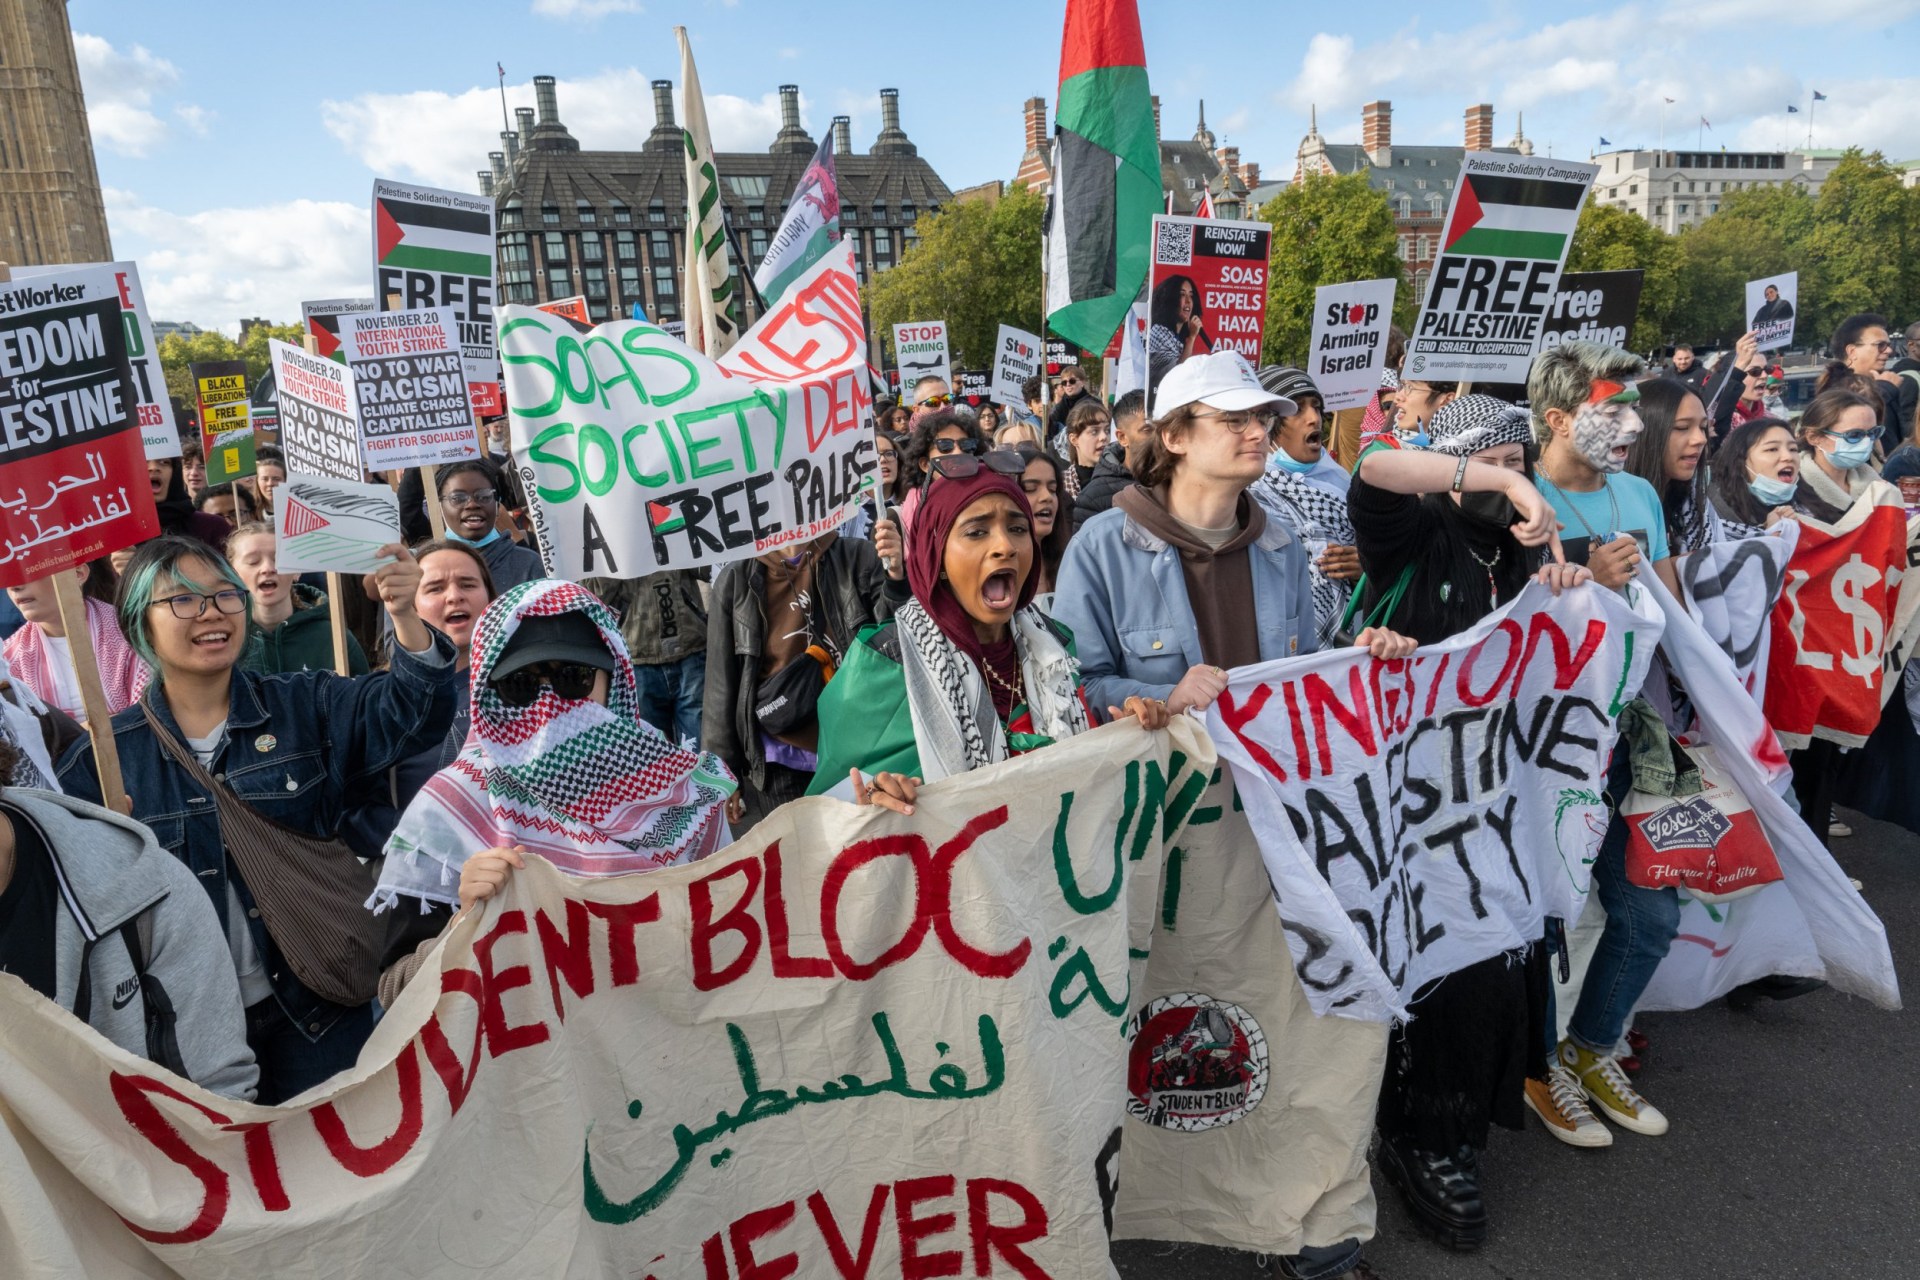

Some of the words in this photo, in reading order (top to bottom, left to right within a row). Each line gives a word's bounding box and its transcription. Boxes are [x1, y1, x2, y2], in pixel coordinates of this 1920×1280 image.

[1467, 159, 1505, 172] Palestine
[1507, 162, 1546, 177] Solidarity
[1547, 166, 1591, 182] Campaign
[377, 185, 411, 199] Palestine
[413, 191, 452, 206] Solidarity
[453, 198, 490, 212] Campaign
[1204, 227, 1257, 242] REINSTATE
[1215, 242, 1246, 256] NOW!
[1220, 266, 1263, 285] SOAS
[1427, 256, 1558, 314] FREE
[13, 283, 86, 311] Worker
[378, 267, 492, 323] FREE
[1205, 292, 1262, 311] EXPELS
[1551, 289, 1604, 319] ree
[307, 305, 343, 314] Palestine
[355, 314, 422, 330] NOVEMBER
[423, 312, 439, 324] 20
[1218, 315, 1260, 333] HAYA
[1419, 312, 1540, 339] PALESTINE
[355, 325, 446, 343] INTERNATIONAL
[899, 326, 942, 342] STOP
[1319, 329, 1379, 351] Arming
[357, 341, 400, 357] YOUTH
[403, 337, 448, 353] STRIKE
[462, 348, 491, 358] PATION
[901, 342, 944, 354] ARMING
[1042, 342, 1065, 352] ree
[1211, 338, 1257, 355] ADAM
[1416, 341, 1436, 352] END
[1438, 341, 1474, 353] ISRAELI
[1475, 342, 1531, 355] OCCUPATION
[282, 348, 328, 378] NOVEMBER
[329, 366, 342, 382] 20
[352, 362, 382, 381] NO
[384, 359, 411, 378] TO
[413, 355, 461, 374] WAR
[500, 317, 700, 418] SOAS
[1000, 354, 1034, 375] Arming
[1045, 353, 1078, 365] estine
[1320, 350, 1373, 375] Israel
[11, 378, 41, 400] for
[207, 377, 238, 390] BLACK
[281, 362, 347, 398] INTERNATIONAL
[357, 373, 464, 405] RACISM
[283, 376, 311, 400] YOUTH
[311, 389, 348, 413] STRIKE
[0, 379, 126, 453] ESTINE
[215, 406, 237, 419] FREE
[280, 394, 299, 416] NO
[301, 404, 318, 426] TO
[321, 411, 357, 441] WAR
[362, 401, 418, 418] CLIMATE
[420, 396, 465, 411] CHAOS
[208, 419, 247, 433] PALESTINE!
[365, 409, 468, 435] CAPITALISM
[142, 436, 168, 446] ition
[284, 415, 358, 467] RACISM
[367, 437, 396, 451] FIGHT
[399, 435, 418, 448] FOR
[420, 429, 475, 445] SOCIALISM
[528, 388, 788, 504] SOCIETY
[286, 441, 323, 469] CLIMATE
[324, 458, 359, 481] CHAOS
[582, 502, 618, 575] A
[645, 471, 782, 566] FREE
[25, 540, 105, 575] socialistworker.co.uk
[109, 890, 662, 1245] STUDENT
[690, 805, 1032, 992] BLOC
